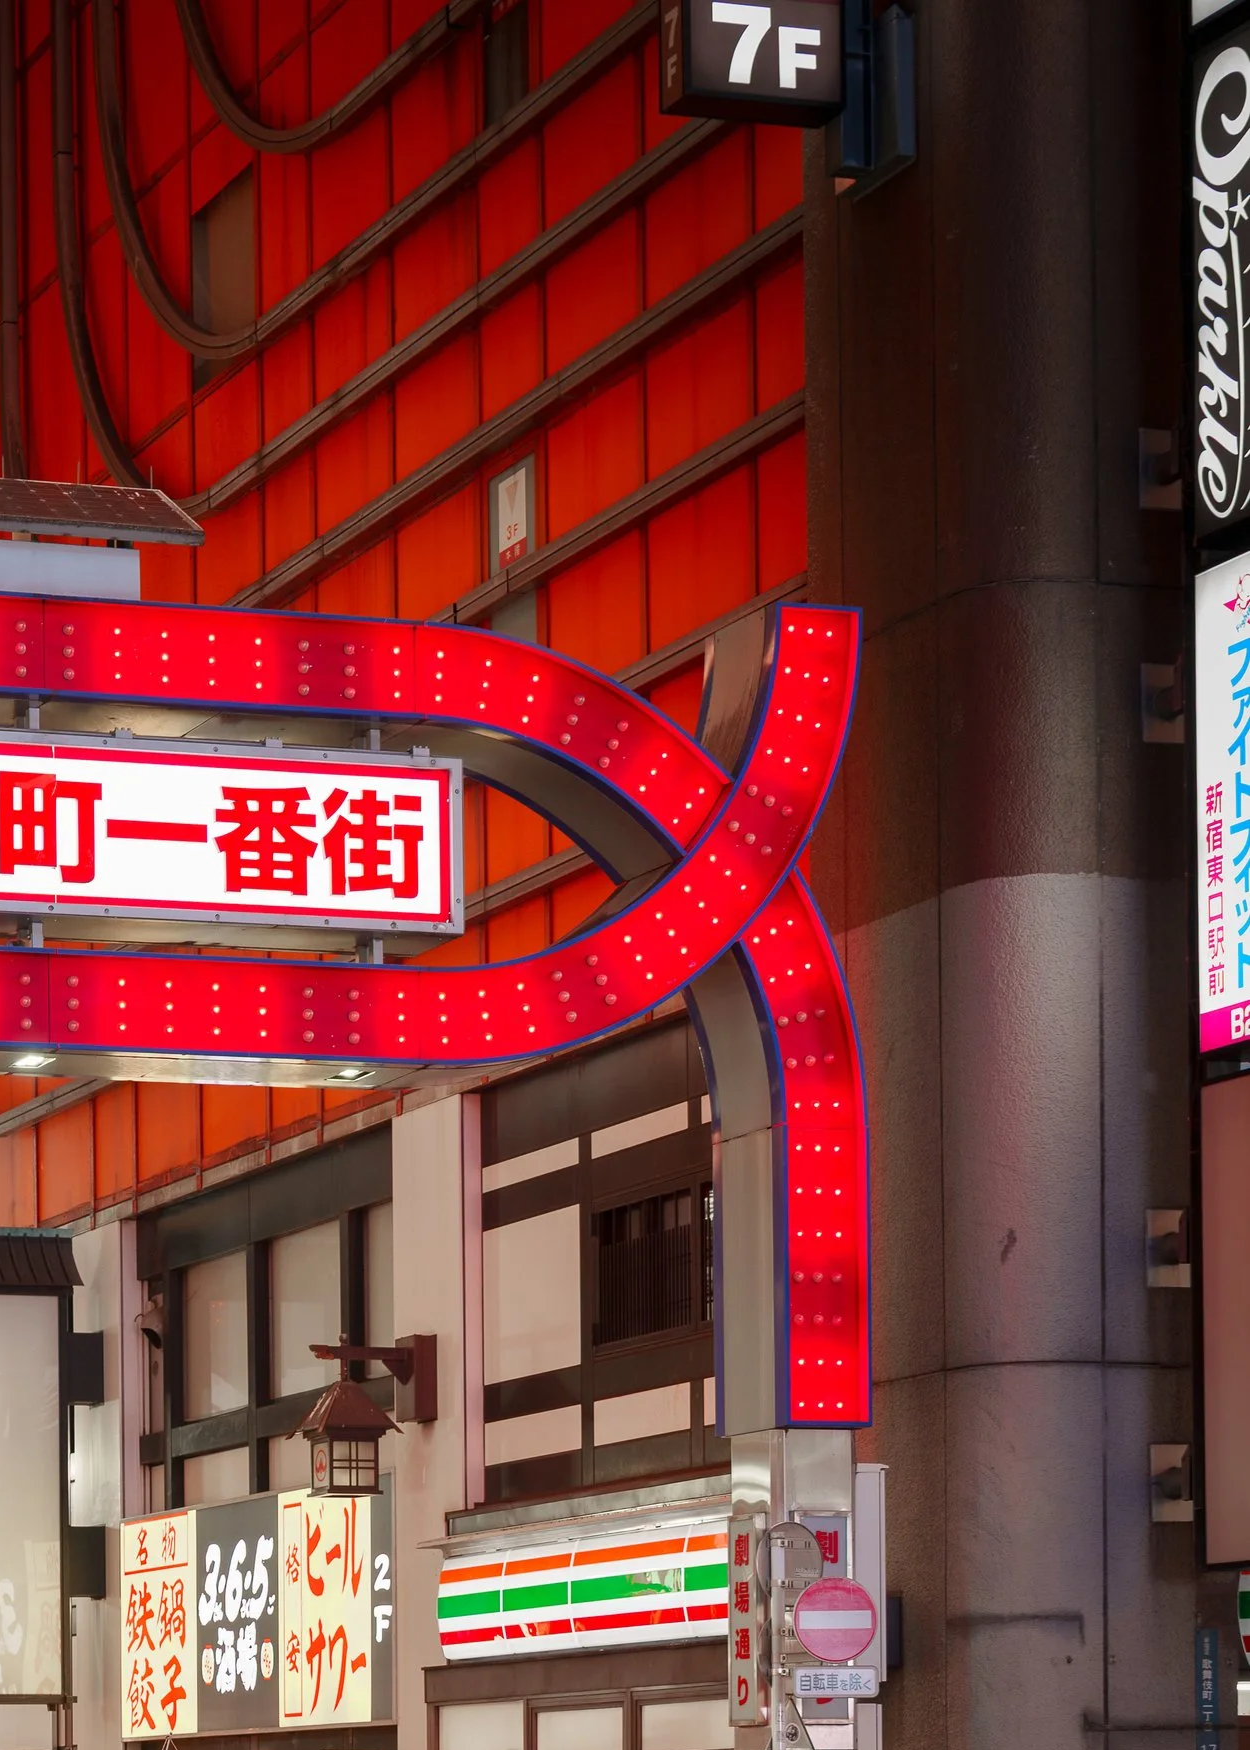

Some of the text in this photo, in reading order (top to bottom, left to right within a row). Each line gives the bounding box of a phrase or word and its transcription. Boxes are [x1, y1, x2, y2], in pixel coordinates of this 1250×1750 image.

[712, 2, 821, 89] 7F
[1205, 781, 1225, 997] 新宿東口駅前
[135, 1521, 177, 1567] 名物
[305, 1497, 365, 1599] ビール
[285, 1542, 302, 1674] 格安
[373, 1553, 393, 1643] 2F
[733, 1531, 750, 1707] 劇場通り
[126, 1655, 188, 1733] 餃子
[215, 1621, 258, 1694] 酒場
[305, 1617, 367, 1714] サワー
[800, 1673, 872, 1693] 自転車を除く
